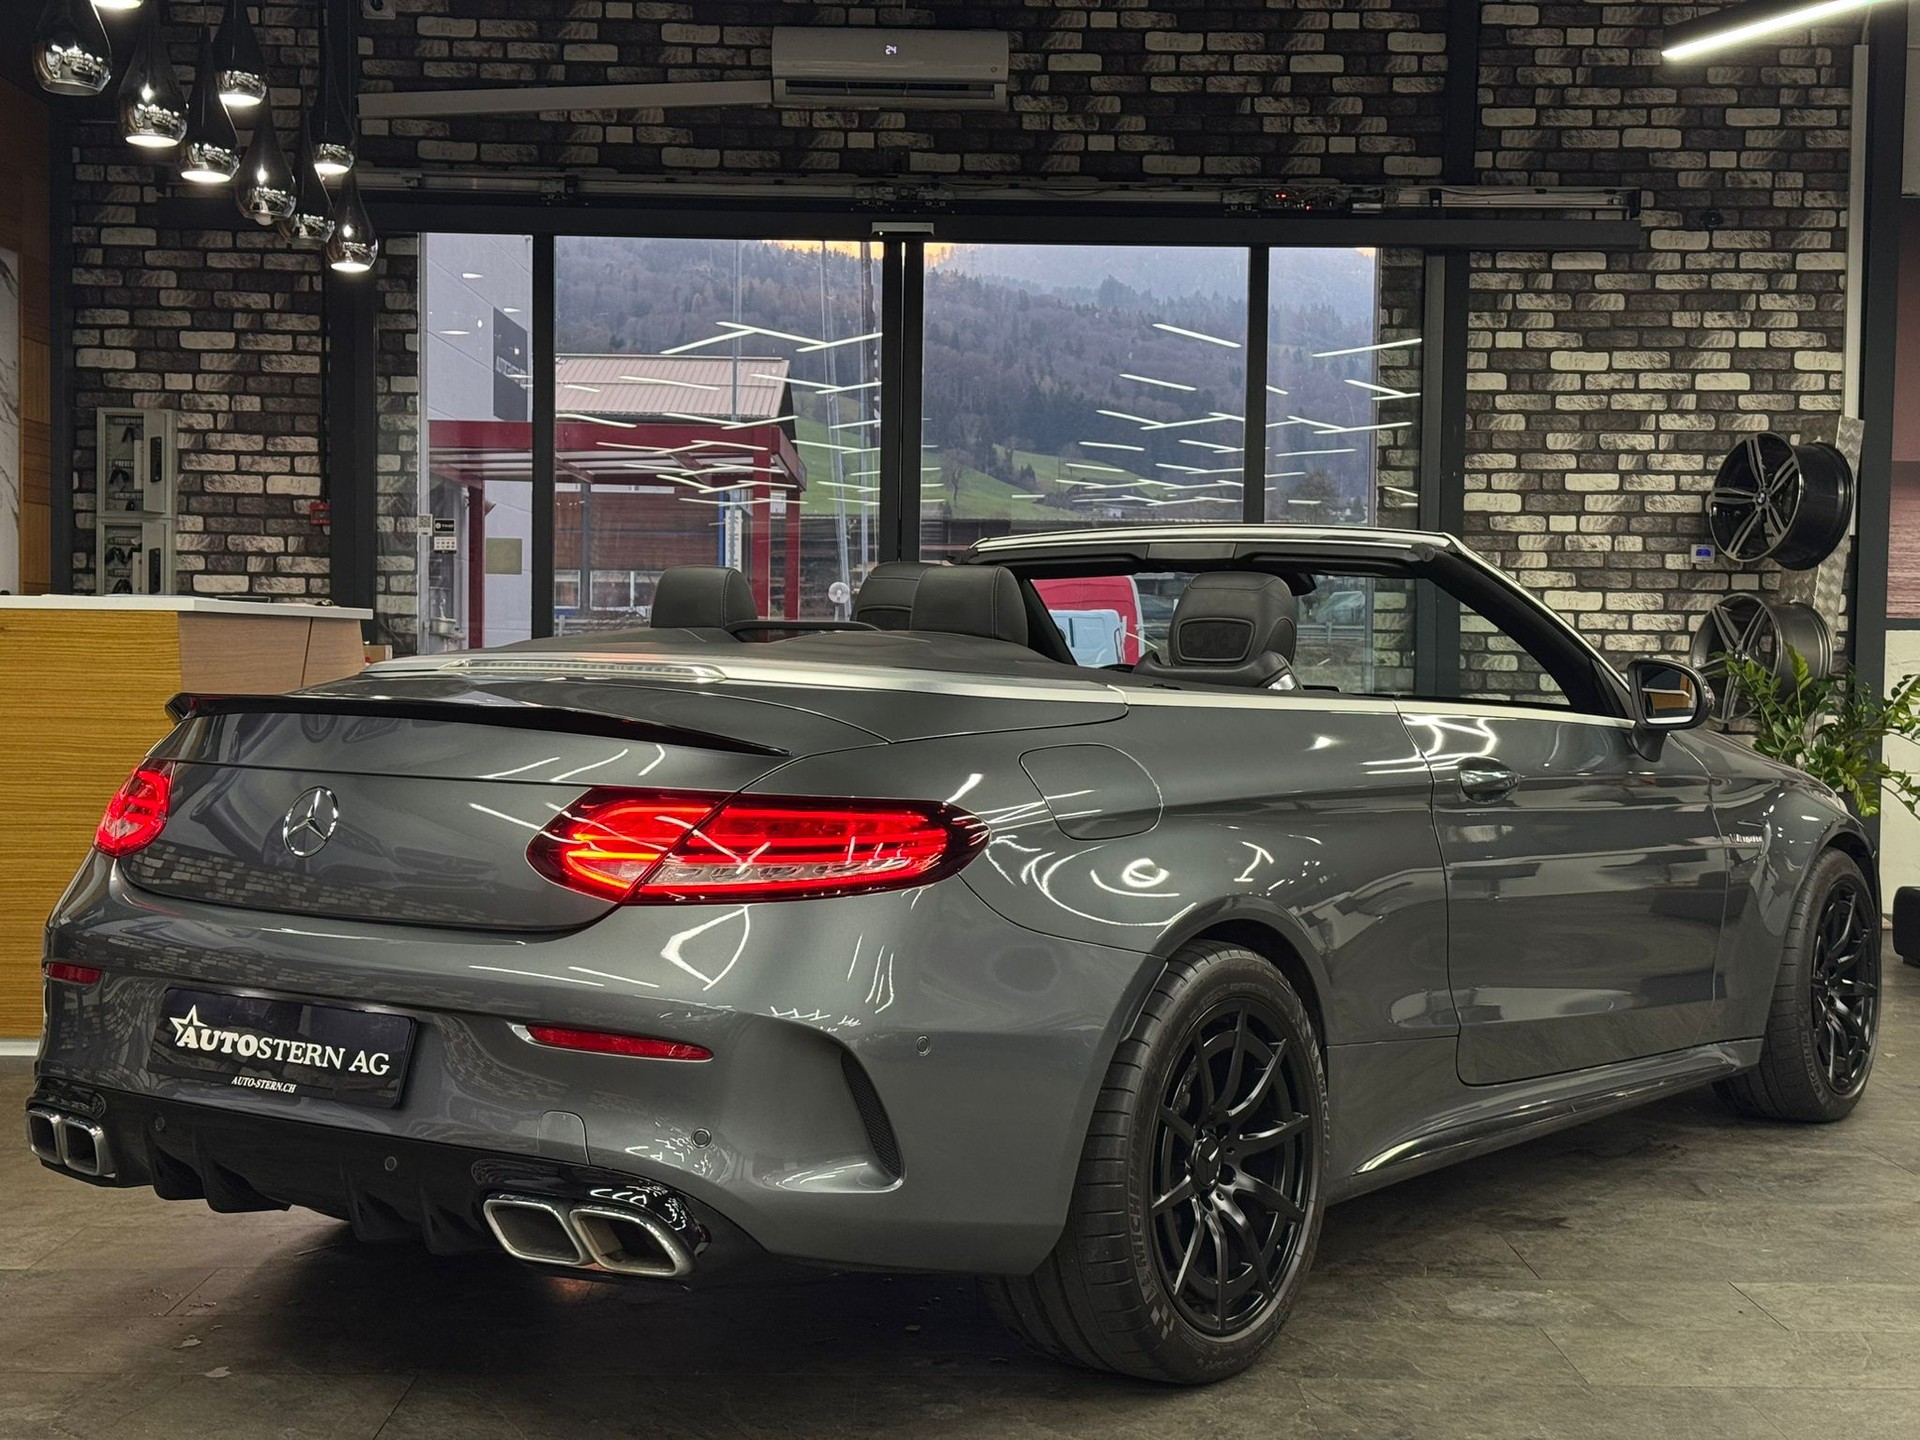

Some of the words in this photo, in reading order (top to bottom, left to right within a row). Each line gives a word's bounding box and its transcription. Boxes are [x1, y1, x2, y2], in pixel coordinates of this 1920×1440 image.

[885, 45, 897, 55] 24
[176, 1026, 345, 1070] AUTOSTERN
[348, 1050, 390, 1076] AG
[231, 1076, 297, 1093] AUTO-STERN.CH
